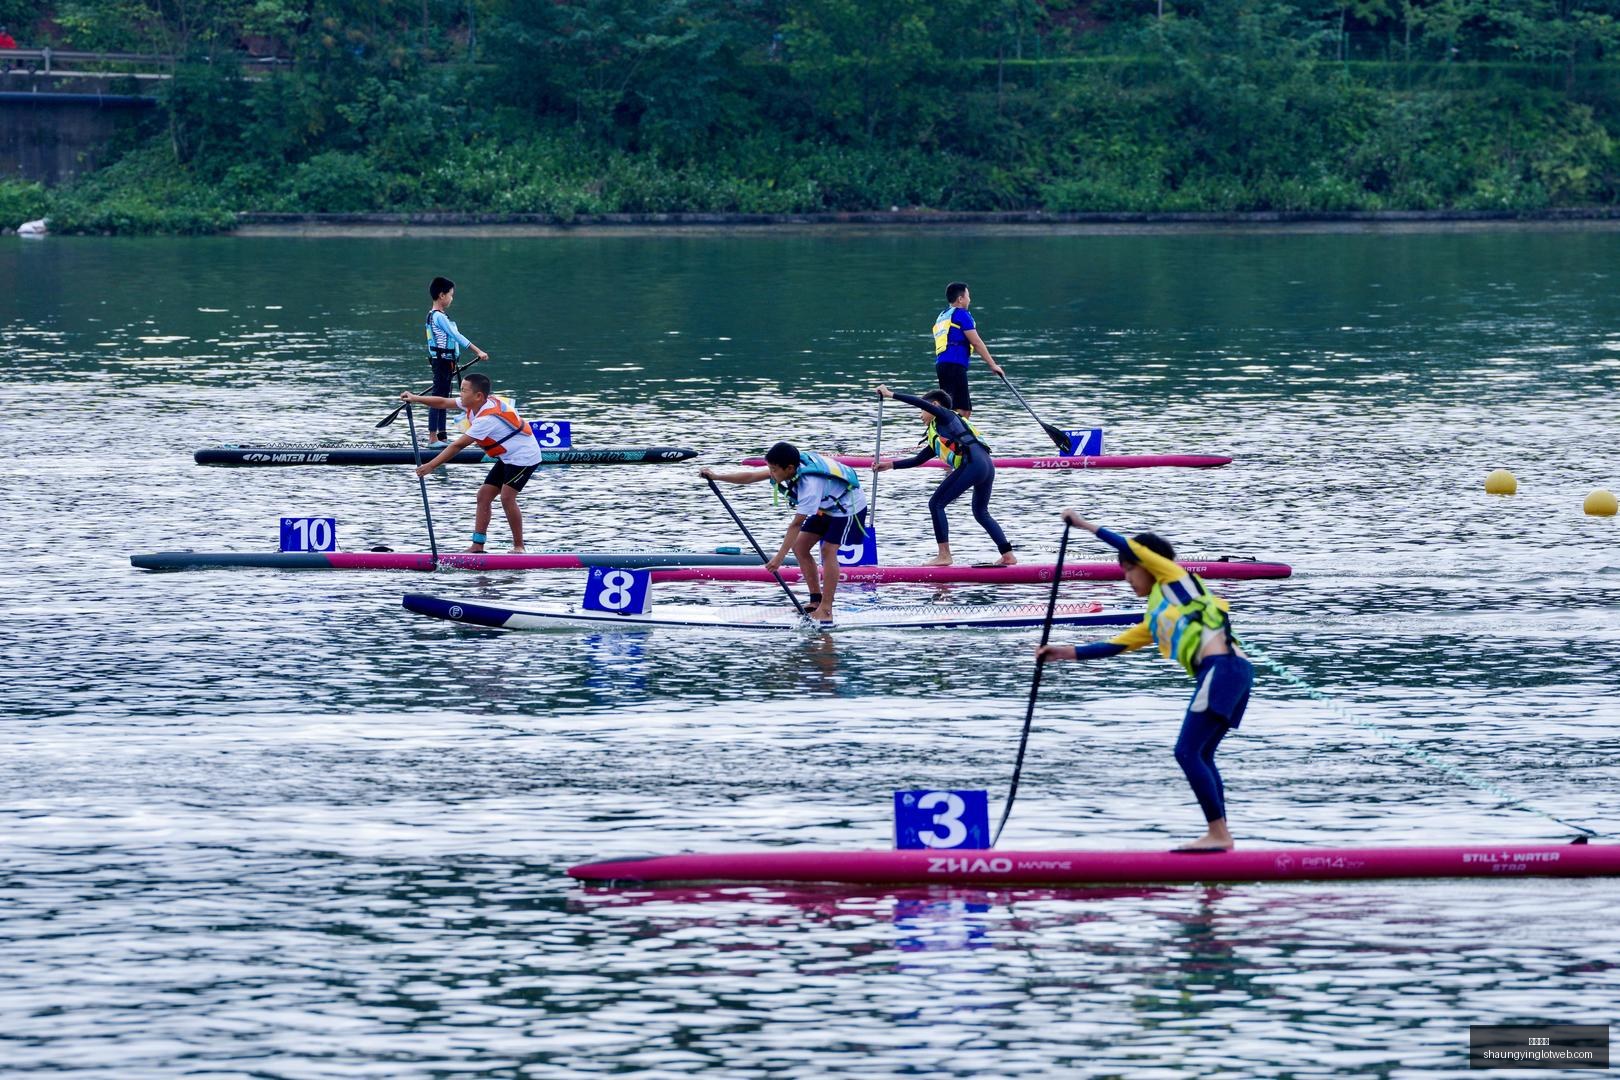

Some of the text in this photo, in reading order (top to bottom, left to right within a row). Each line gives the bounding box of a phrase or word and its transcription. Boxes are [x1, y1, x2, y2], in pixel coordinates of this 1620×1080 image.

[539, 422, 561, 447] 3
[1072, 431, 1092, 456] 7
[271, 453, 329, 462] WATER LIVE
[293, 518, 332, 551] 10
[598, 570, 634, 609] 8
[917, 791, 968, 849] 3
[927, 857, 1072, 873] ZHAO MARINE
[1462, 852, 1560, 863] STILL WATER
